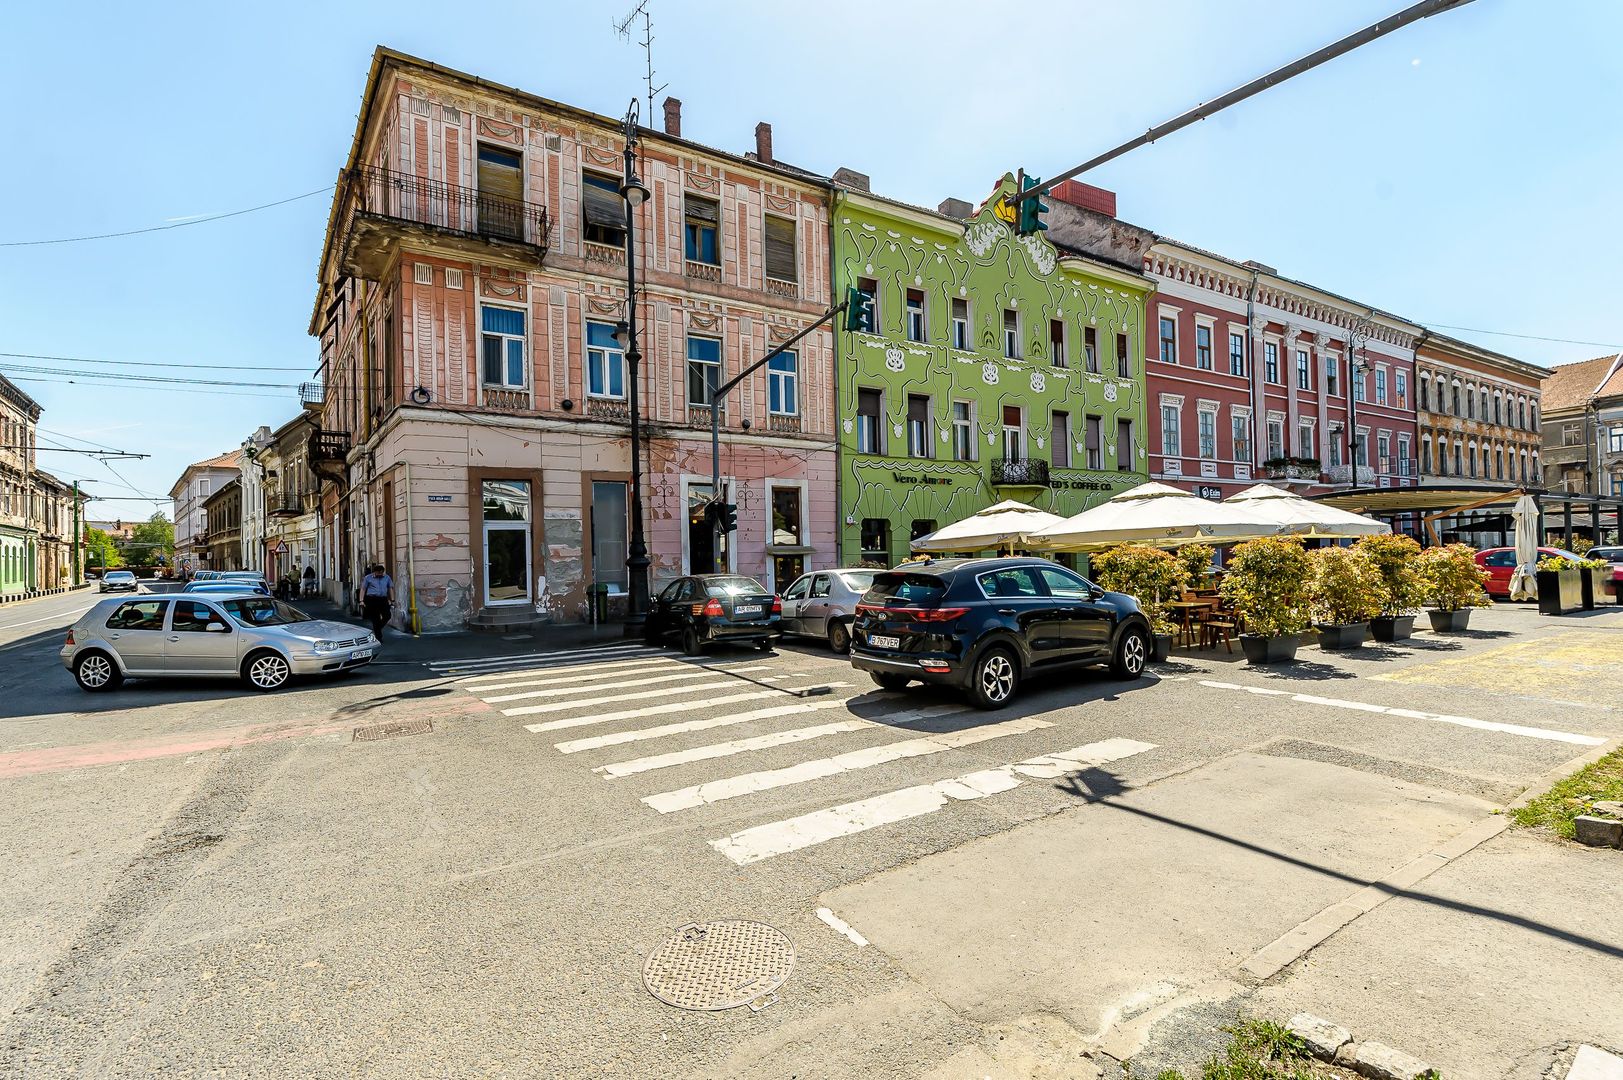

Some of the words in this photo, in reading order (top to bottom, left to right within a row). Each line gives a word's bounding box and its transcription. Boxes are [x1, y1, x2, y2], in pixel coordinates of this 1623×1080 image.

[893, 472, 917, 483] Vero
[919, 474, 953, 485] Amore
[1071, 481, 1100, 490] COFFEE
[1100, 483, 1114, 491] CO.
